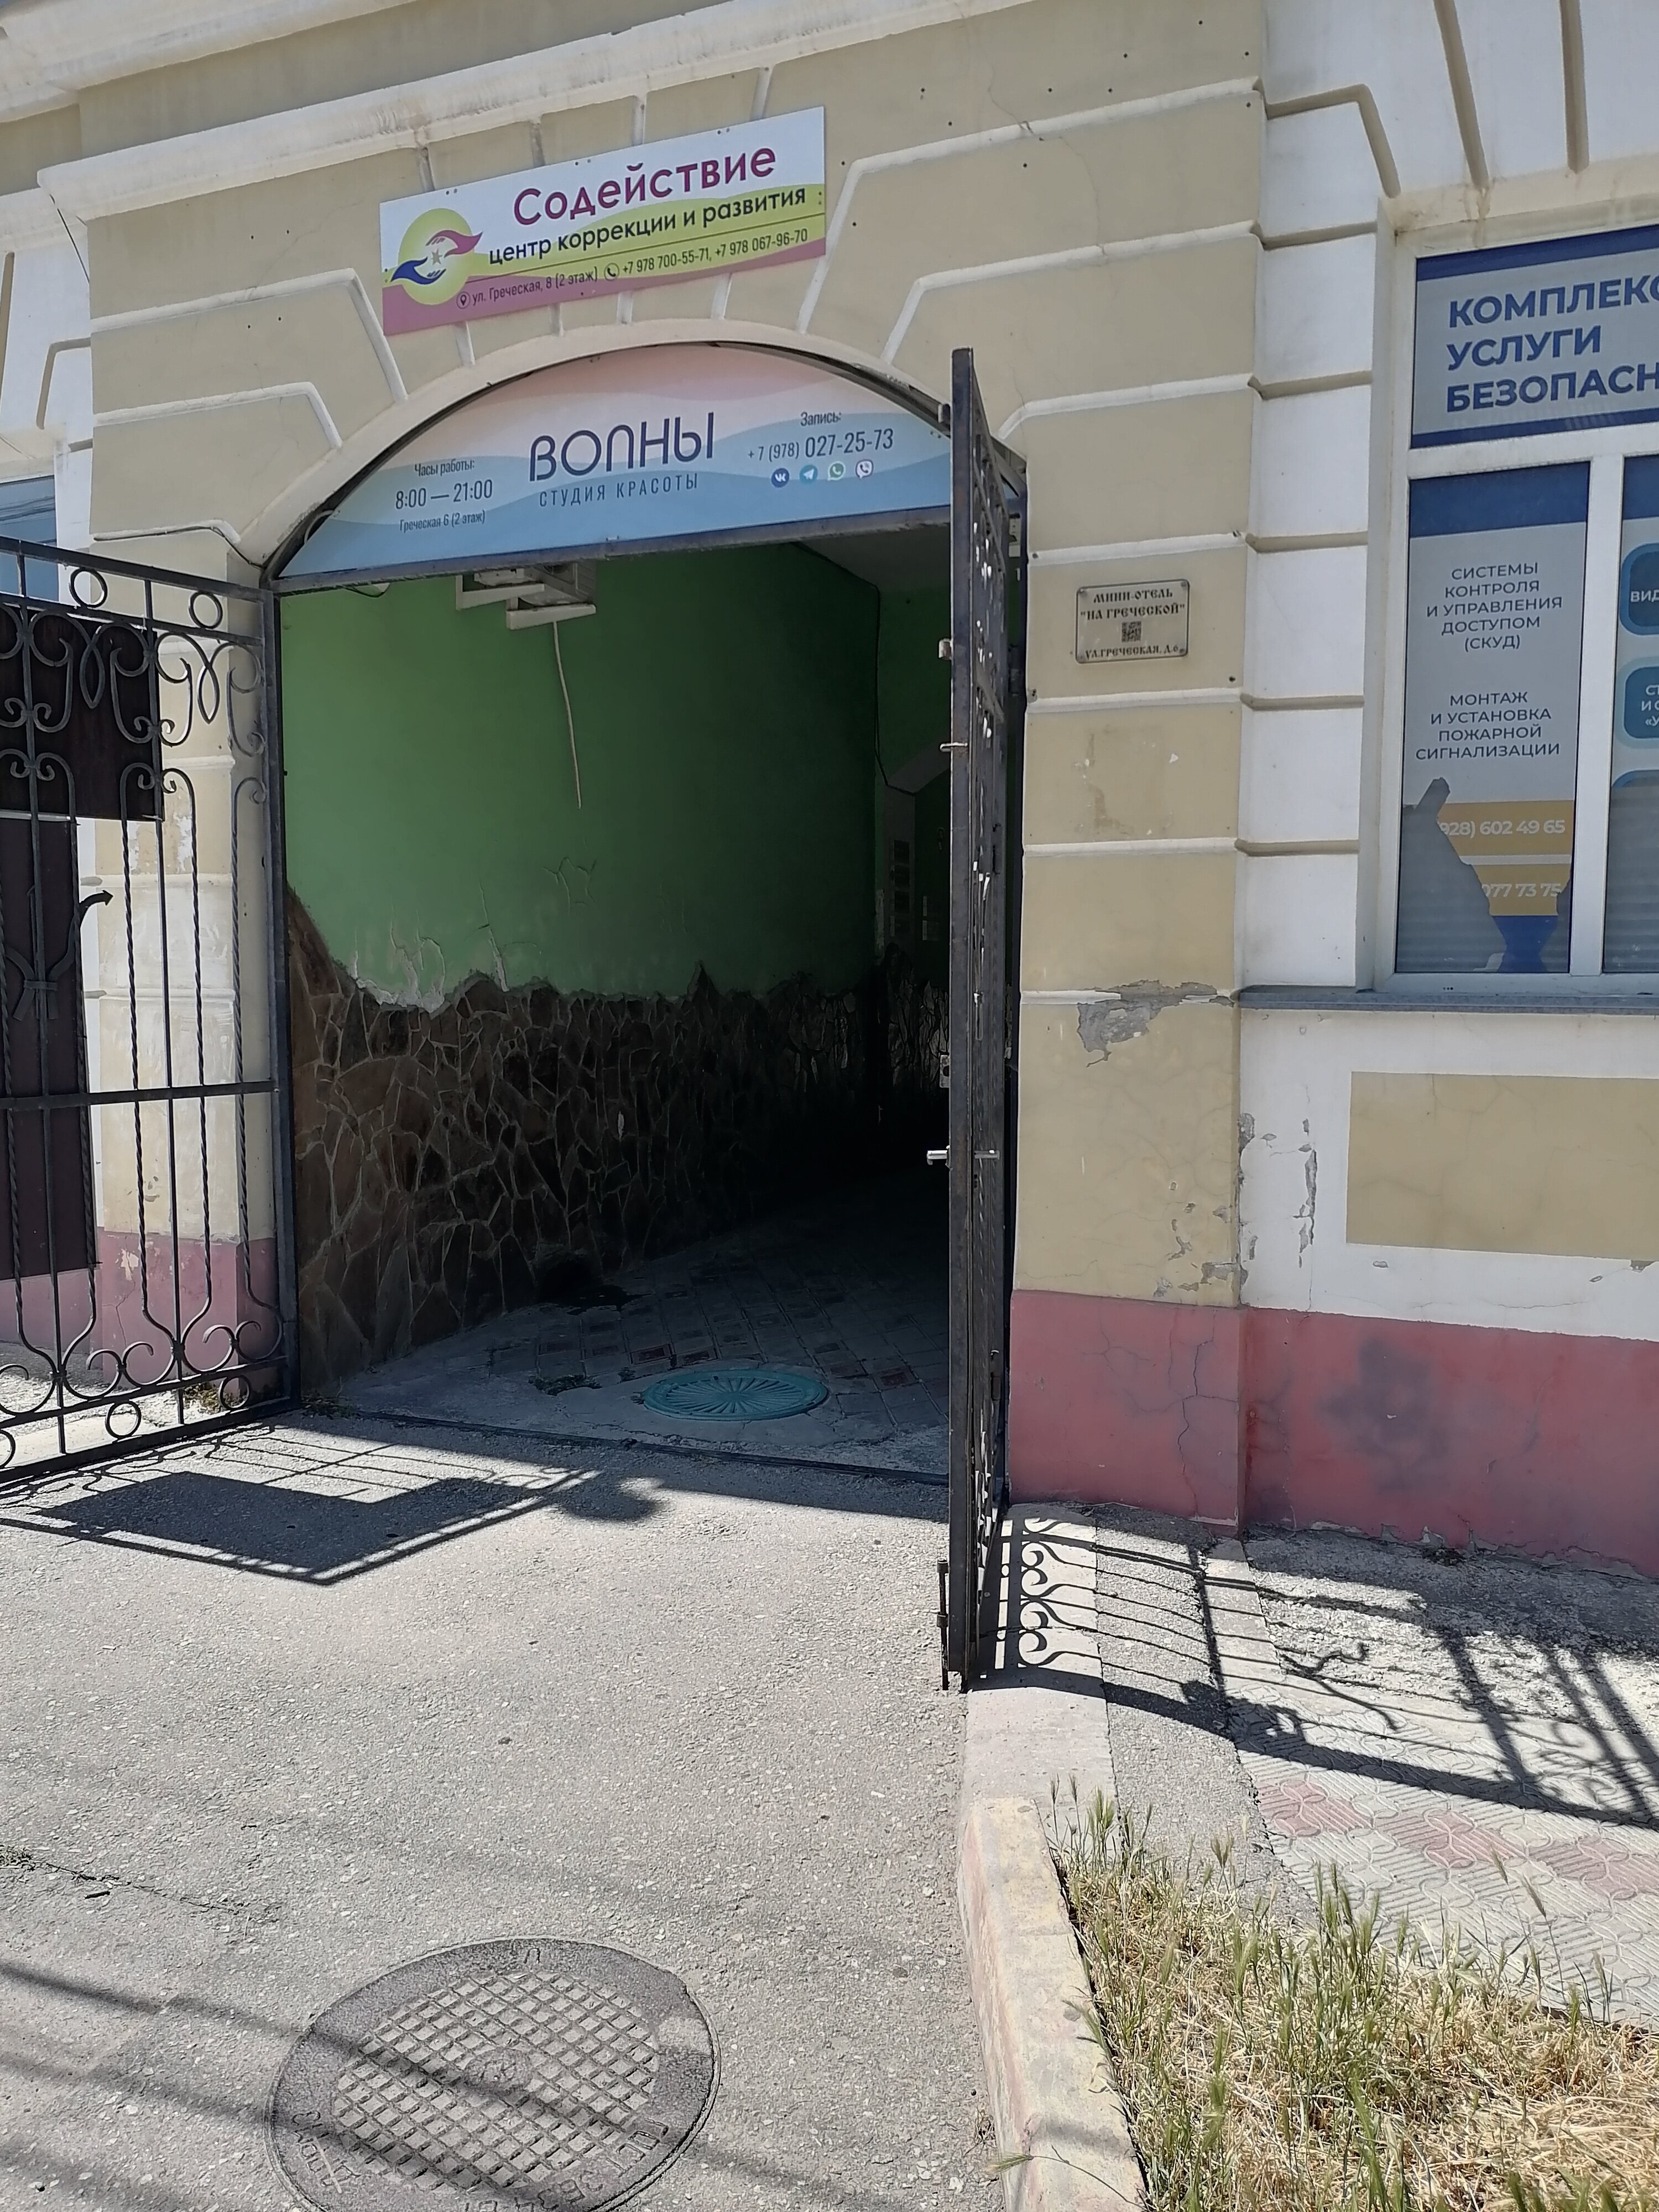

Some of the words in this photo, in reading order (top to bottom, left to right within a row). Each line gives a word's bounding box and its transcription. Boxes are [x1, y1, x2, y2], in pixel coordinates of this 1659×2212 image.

[514, 148, 775, 225] Содействие
[490, 238, 551, 264] центр
[558, 213, 676, 251] коррекции
[684, 210, 695, 226] и
[703, 188, 805, 228] развития
[623, 261, 633, 274] +7
[637, 257, 655, 272] 978
[658, 247, 712, 269] 700-55-71,
[715, 244, 726, 257] +7
[730, 239, 748, 255] 978
[752, 228, 807, 251] 067-96-70
[472, 293, 486, 305] ул.
[489, 281, 542, 301] Греческая,
[546, 276, 552, 289] 8
[555, 273, 565, 289] (2
[568, 266, 597, 285] этаж)
[1447, 325, 1601, 371] УСЛУГИ
[1447, 362, 1659, 413] БЕЗОПАСН
[801, 412, 842, 426] Запись:
[769, 442, 799, 462] (978)
[805, 428, 893, 457] 027-25-73
[415, 463, 438, 477] Часы
[440, 458, 474, 476] работы:
[396, 488, 426, 509] 8:00
[453, 479, 492, 502] 21:00
[539, 485, 606, 507] СТУДИЯ
[617, 473, 698, 498] КРАСОТЫ
[400, 518, 441, 533] Греческая
[444, 514, 448, 525] 6
[452, 513, 460, 527] (2
[462, 510, 485, 524] этаж)
[1452, 562, 1538, 580] СИСТЕМЫ
[1445, 581, 1539, 598] КОНТРОЛЯ
[1081, 609, 1103, 620] "НА
[1105, 603, 1185, 619] ГРЕЧЕСКОЙ"
[1427, 606, 1438, 617] И
[1443, 597, 1562, 616] УПРАВЛЕНИЯ
[1442, 616, 1540, 636] ДОСТУПОМ
[1465, 635, 1520, 652] (СКУД)
[1450, 691, 1528, 706] МОНТАЖ
[1641, 700, 1651, 711] И
[1431, 714, 1441, 724] И
[1447, 708, 1552, 724] УСТАНОВКА
[1439, 723, 1541, 742] ПОЖАРНОЙ
[1416, 743, 1559, 760] СИГНАЛИЗАЦИИ
[1480, 821, 1512, 835] 602
[1516, 820, 1540, 834] 49
[1543, 820, 1565, 833] 65
[1516, 884, 1536, 897] 73
[1541, 883, 1562, 896] 75
[607, 2117, 669, 2178] ГОСТ
